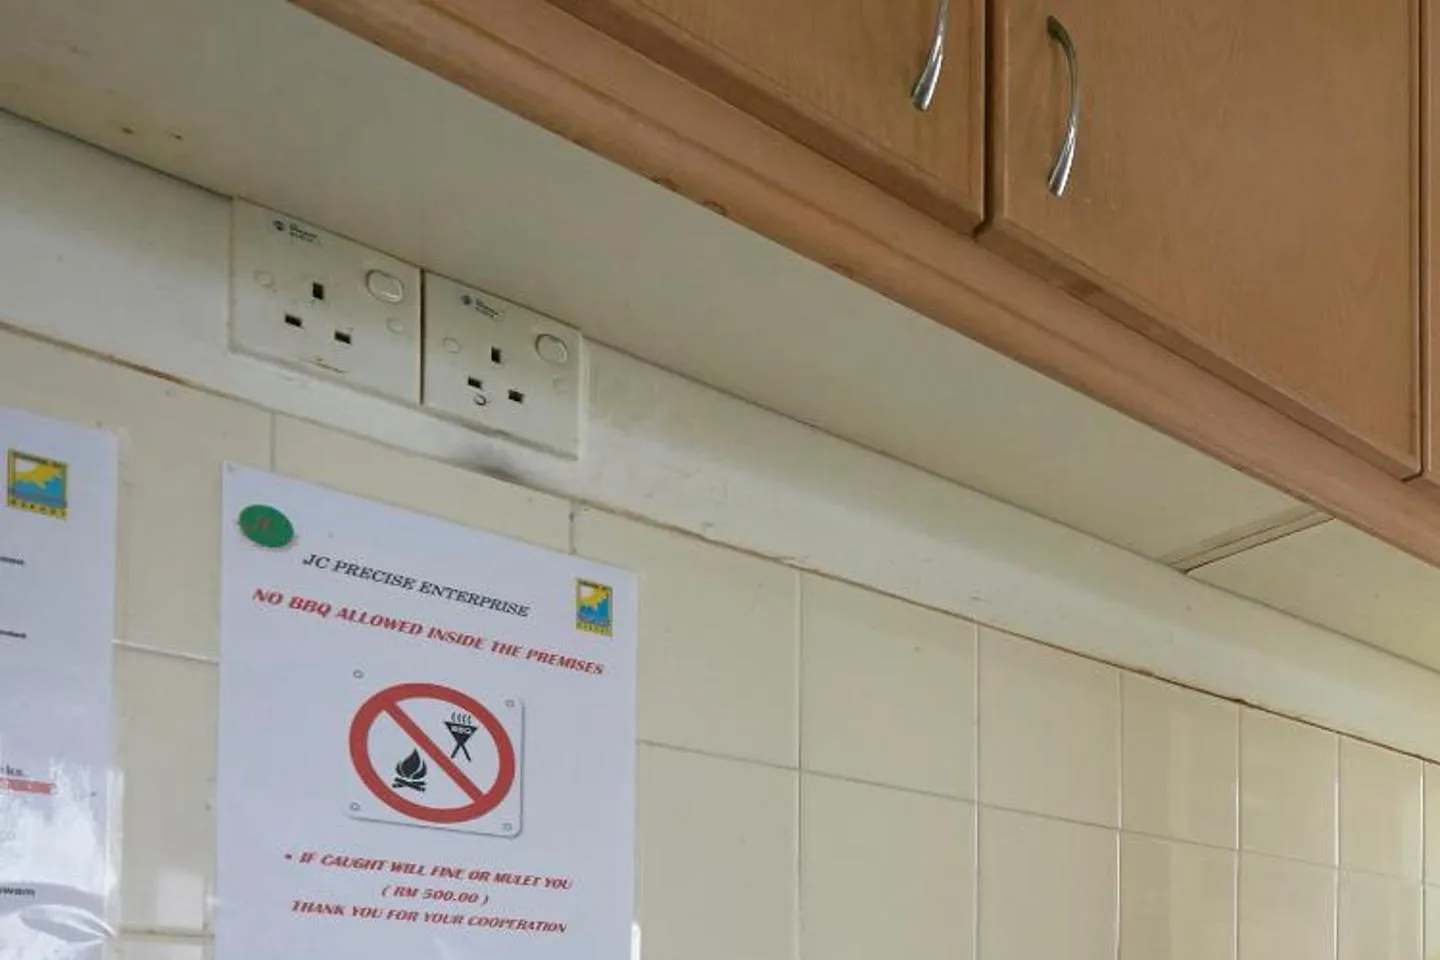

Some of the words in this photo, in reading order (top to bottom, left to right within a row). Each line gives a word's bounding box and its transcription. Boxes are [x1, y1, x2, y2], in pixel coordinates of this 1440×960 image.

[303, 554, 329, 569] JC
[334, 561, 415, 591] PRECISE
[420, 581, 531, 618] ENTERPRISE
[252, 588, 283, 606] NO
[288, 595, 332, 619] BBQ
[335, 607, 423, 637] ALLOWED
[426, 627, 486, 651] INSIDE
[490, 640, 522, 660] THE
[525, 648, 605, 676] PREMISES
[299, 852, 317, 864] IF
[320, 854, 387, 871] CAUGHT
[390, 861, 427, 877] WILL
[430, 865, 465, 880] FINE
[469, 869, 491, 882] OR
[543, 876, 573, 890] YOU
[393, 887, 418, 899] RM
[422, 888, 478, 904] 500.00
[291, 899, 346, 916] THANK
[351, 906, 383, 919] YOU
[386, 909, 418, 922] FOR
[423, 911, 464, 926] YOUR
[468, 915, 567, 933] COOPERATION
